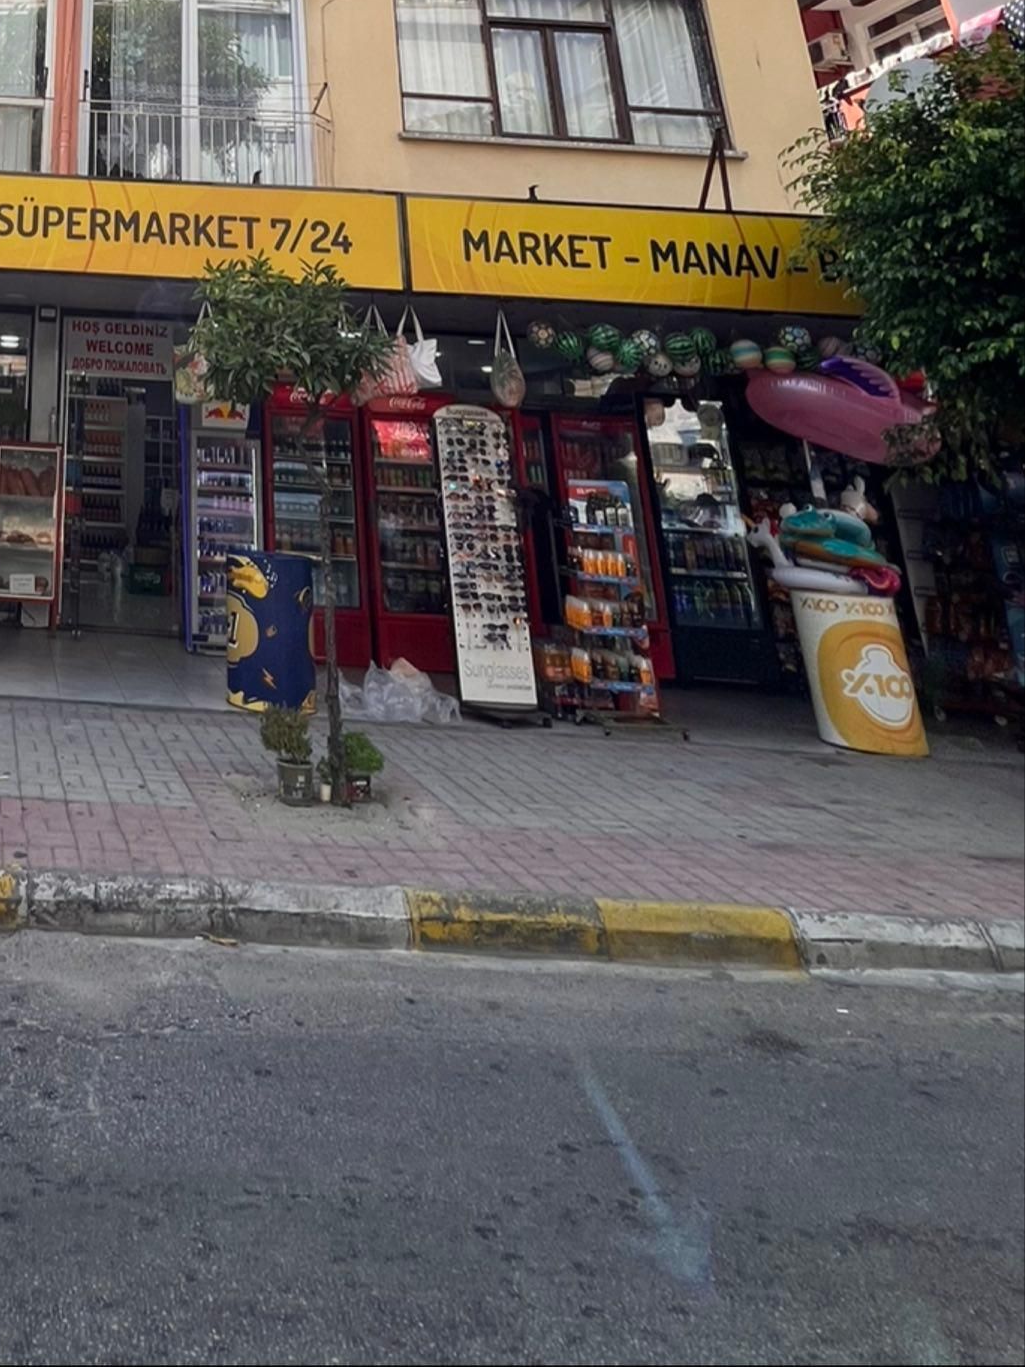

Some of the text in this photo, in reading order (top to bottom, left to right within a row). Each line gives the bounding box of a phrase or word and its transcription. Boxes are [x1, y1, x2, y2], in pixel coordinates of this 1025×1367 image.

[270, 217, 354, 255] 7/24
[461, 228, 612, 271] MARKET
[650, 238, 779, 280] MANAV
[71, 320, 168, 338] HOŞ GELDİNİZ
[86, 339, 154, 357] WELCOME
[71, 356, 168, 376] ДОБРО ПОЖАЛОВАТЬ
[463, 659, 530, 684] Sunglasses
